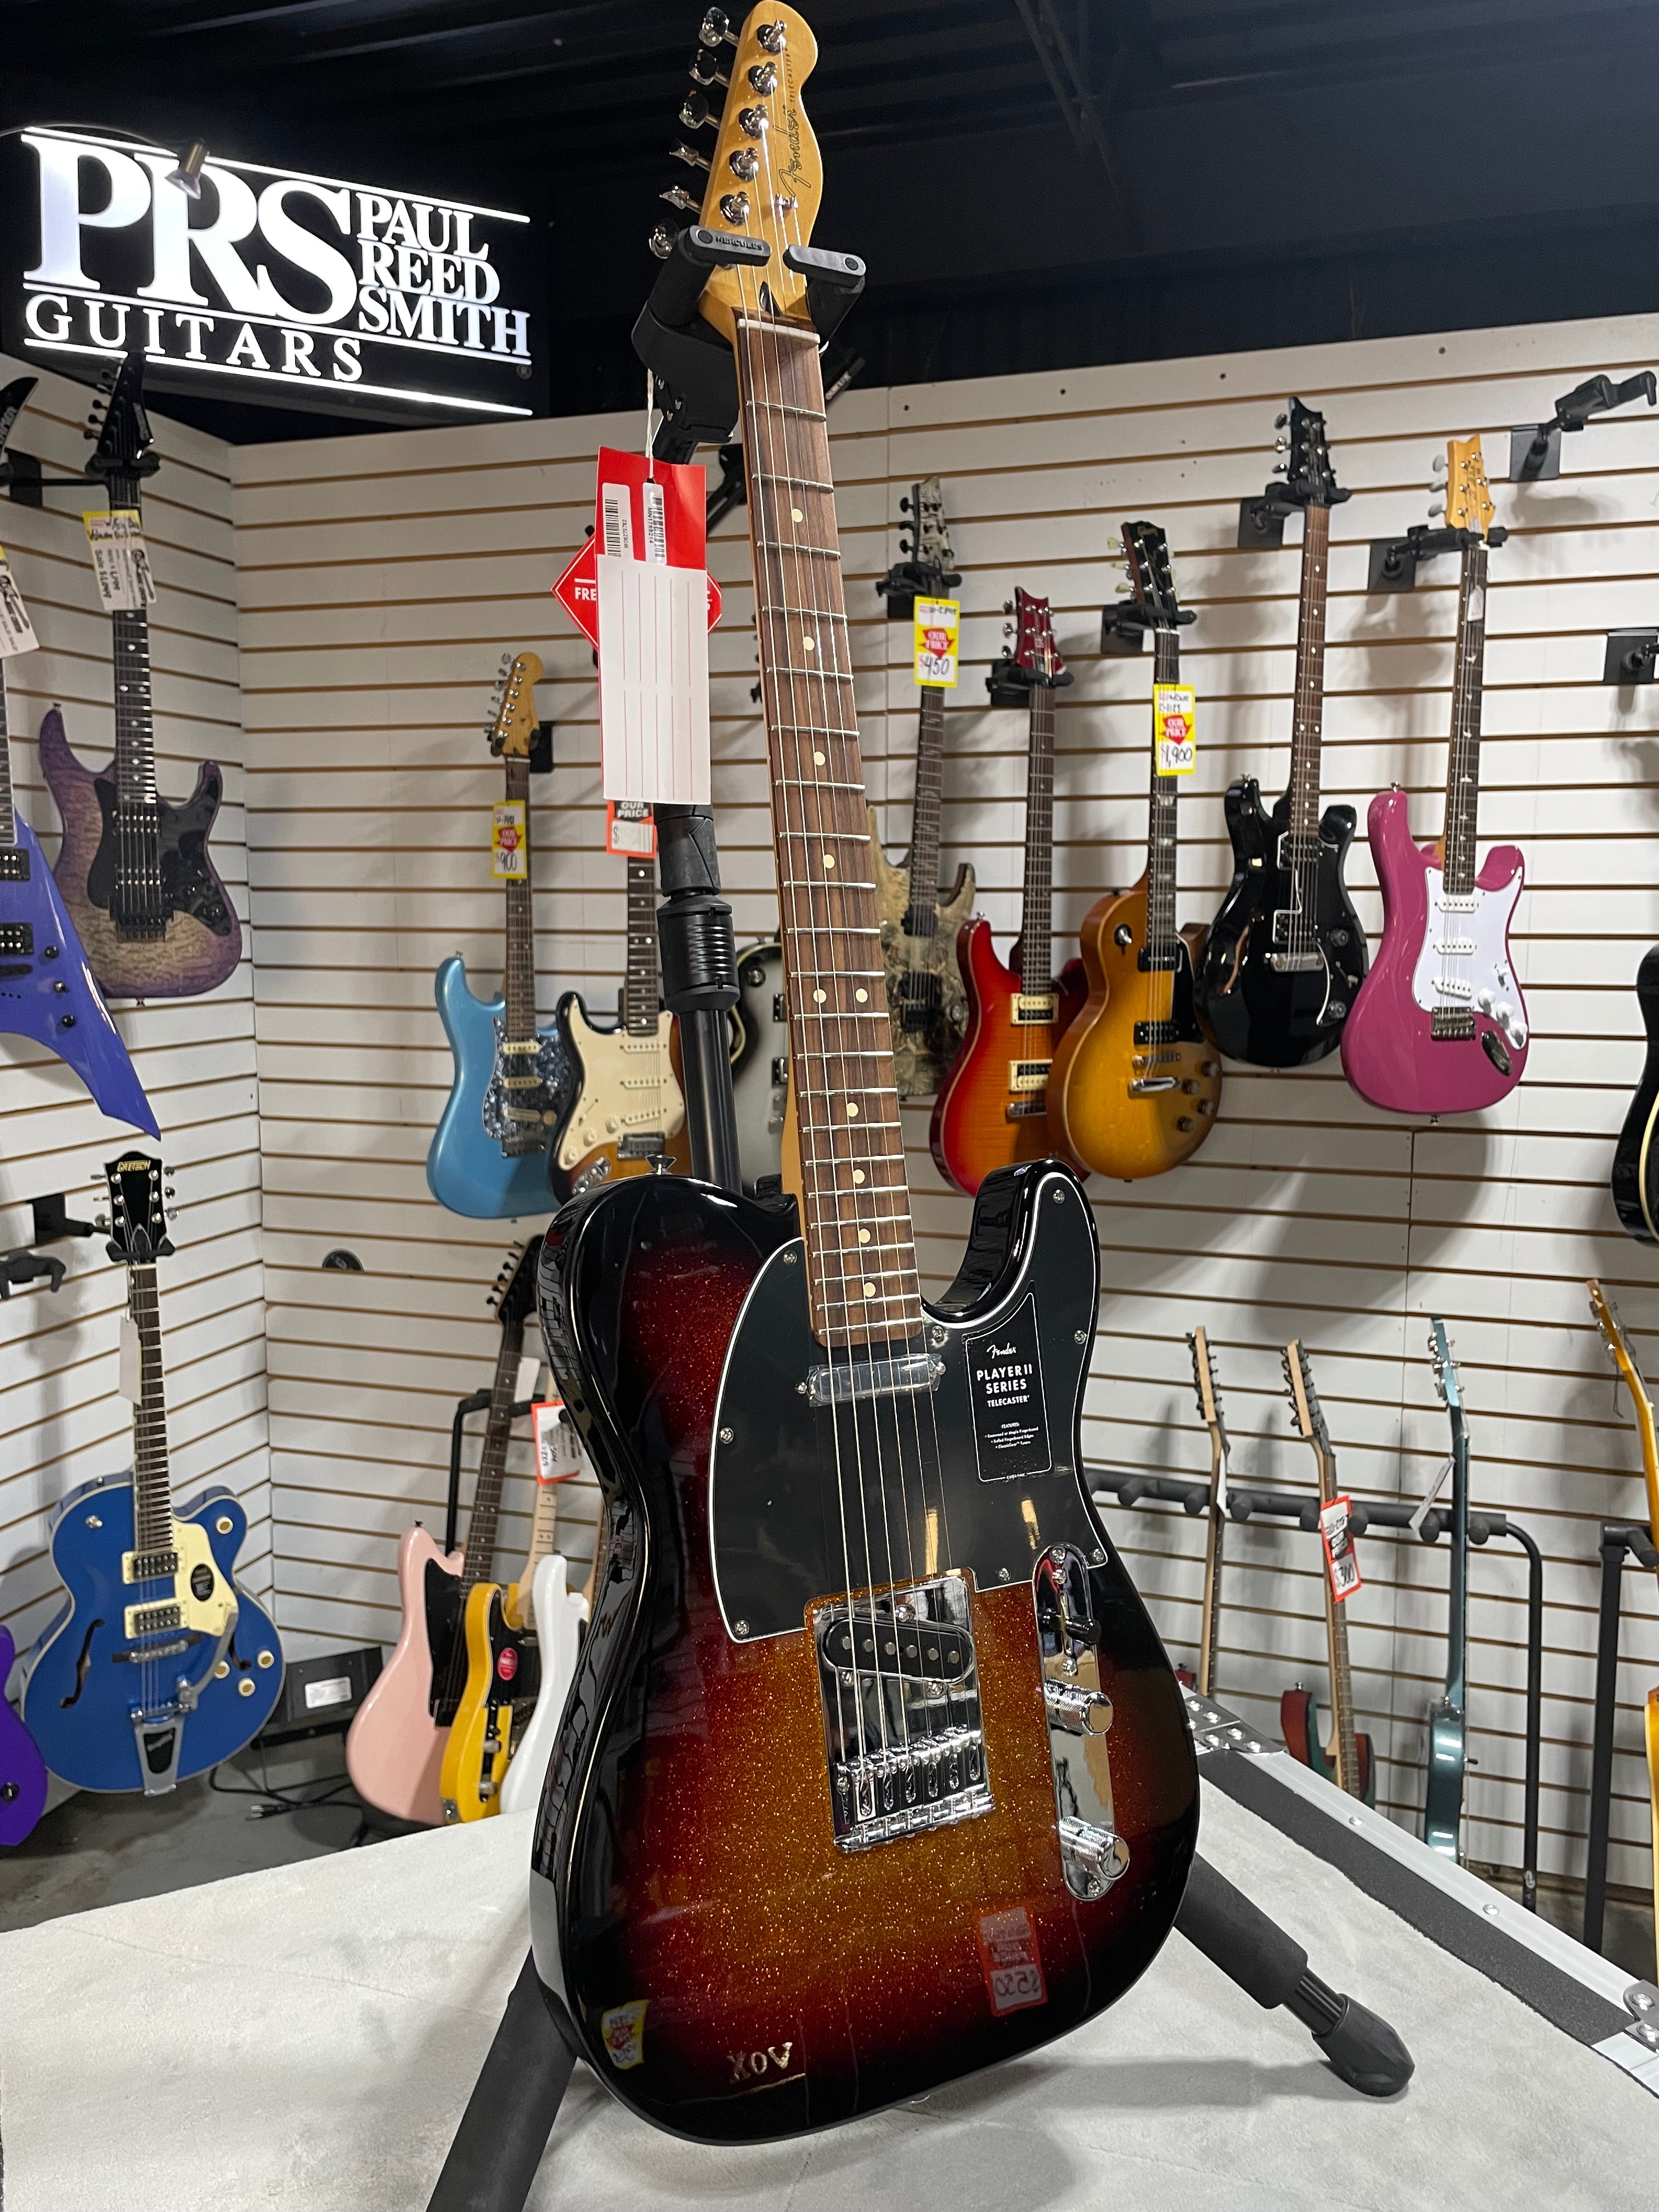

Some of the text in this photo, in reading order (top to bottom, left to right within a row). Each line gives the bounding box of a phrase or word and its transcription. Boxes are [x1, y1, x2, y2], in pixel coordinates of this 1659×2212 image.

[786, 52, 795, 103] TELECASTER
[773, 108, 811, 197] Fender
[21, 133, 357, 325] PRS
[356, 191, 489, 259] PAUL
[715, 236, 763, 251] HERCULES
[357, 238, 501, 306] REED
[25, 293, 363, 381] GUITARS
[358, 286, 531, 358] SMITH
[617, 809, 649, 818] PRICE
[117, 1160, 151, 1172] GRETSCH
[977, 1363, 1032, 1381] PLAYER II
[986, 1342, 1016, 1359] Fender
[985, 1378, 1027, 1395] SERIES
